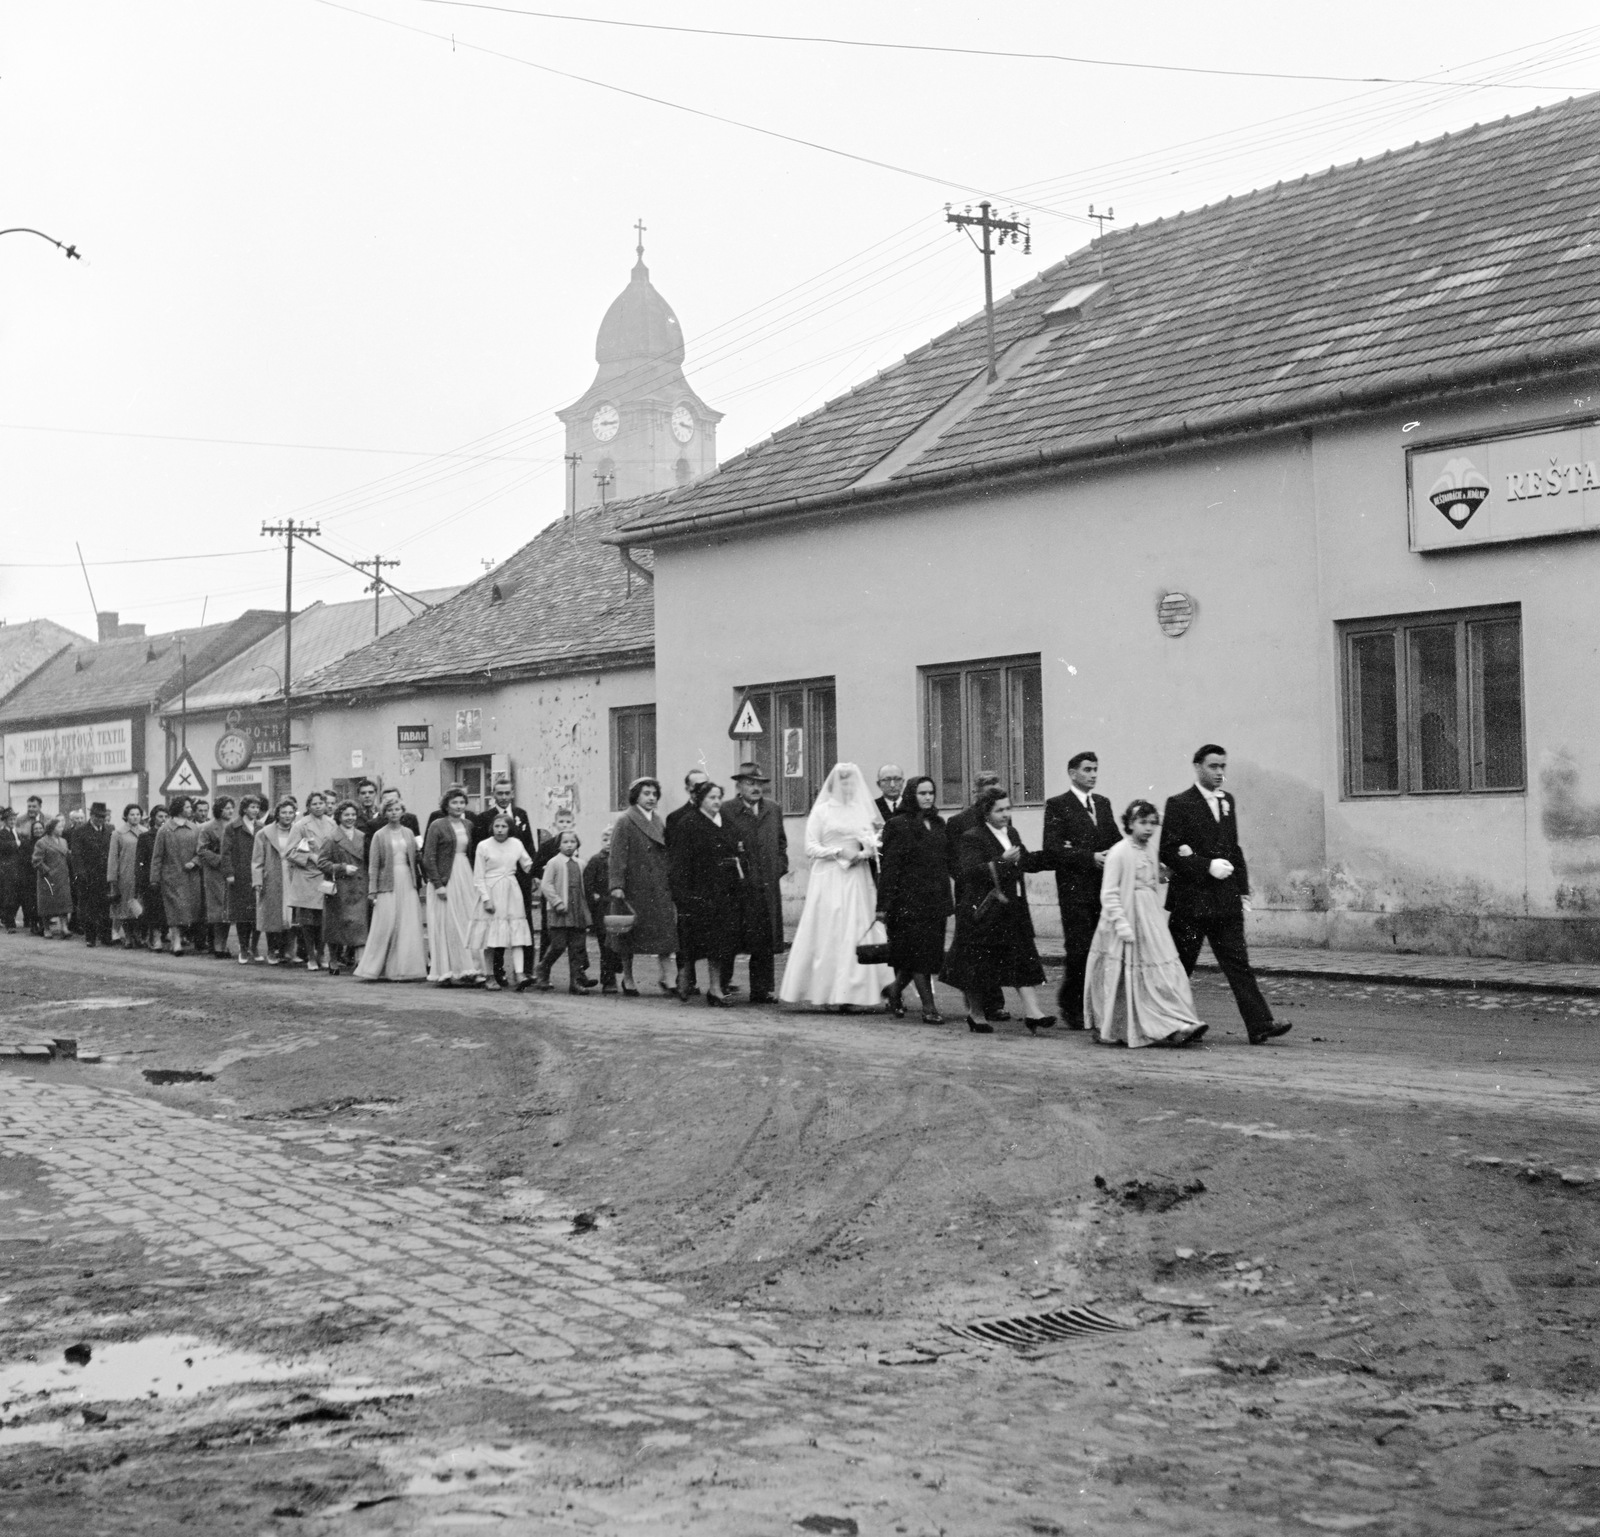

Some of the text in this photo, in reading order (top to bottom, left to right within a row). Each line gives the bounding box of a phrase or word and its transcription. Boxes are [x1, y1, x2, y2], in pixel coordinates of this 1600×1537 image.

[97, 728, 126, 746] TEXTIL
[400, 731, 427, 742] TABAK
[104, 749, 127, 765] TEXTIL
